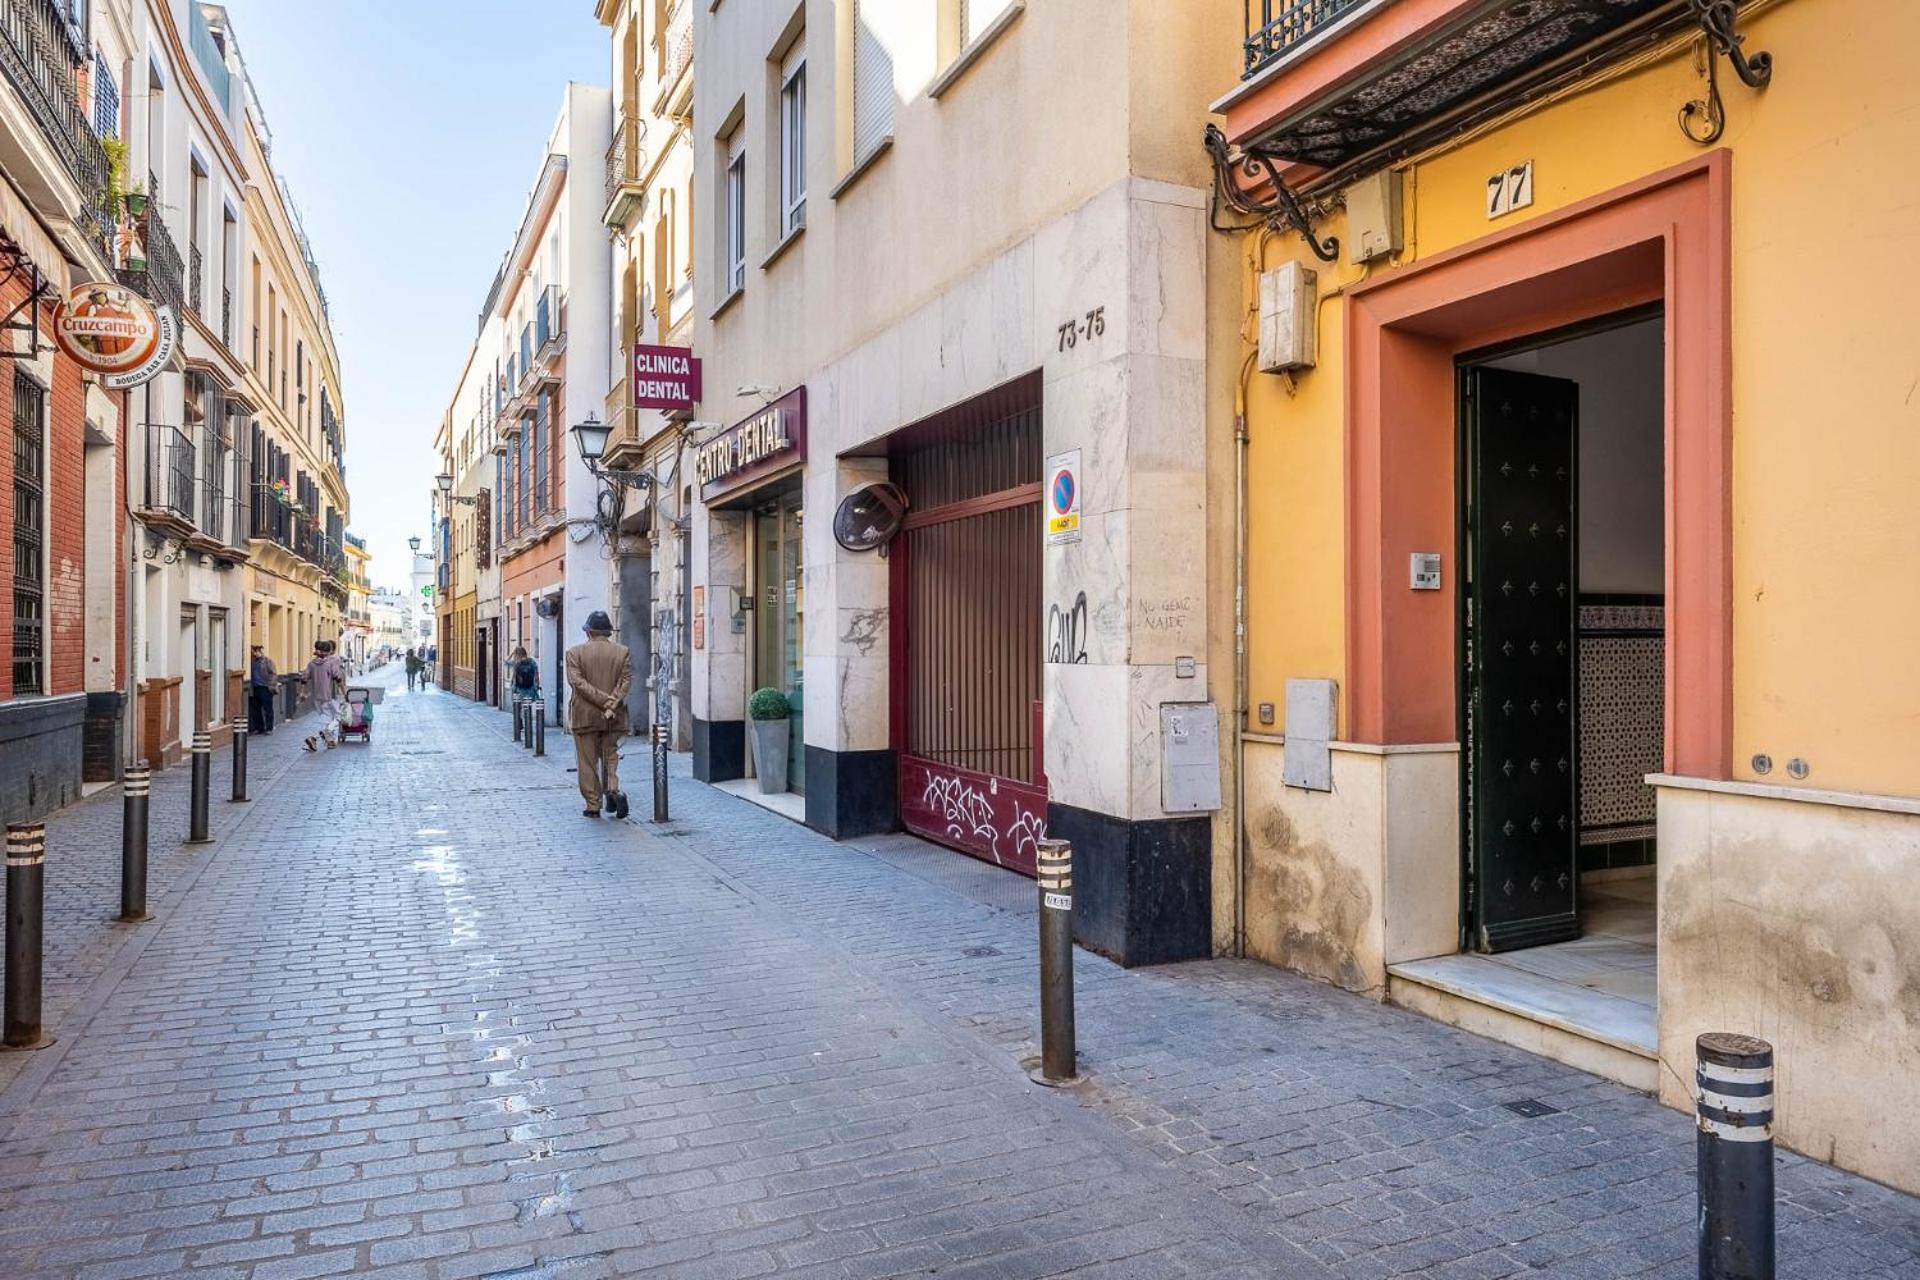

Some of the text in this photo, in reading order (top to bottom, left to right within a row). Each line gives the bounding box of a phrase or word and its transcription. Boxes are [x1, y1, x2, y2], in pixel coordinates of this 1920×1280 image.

[1487, 161, 1529, 213] 77
[62, 317, 147, 335] Cruzcampo
[1058, 305, 1106, 352] 73-75
[115, 371, 147, 385] BODEGA
[146, 360, 161, 374] BAR
[636, 354, 690, 375] CLINICA
[638, 380, 690, 400] DENTAL
[737, 407, 786, 468] DENTAL
